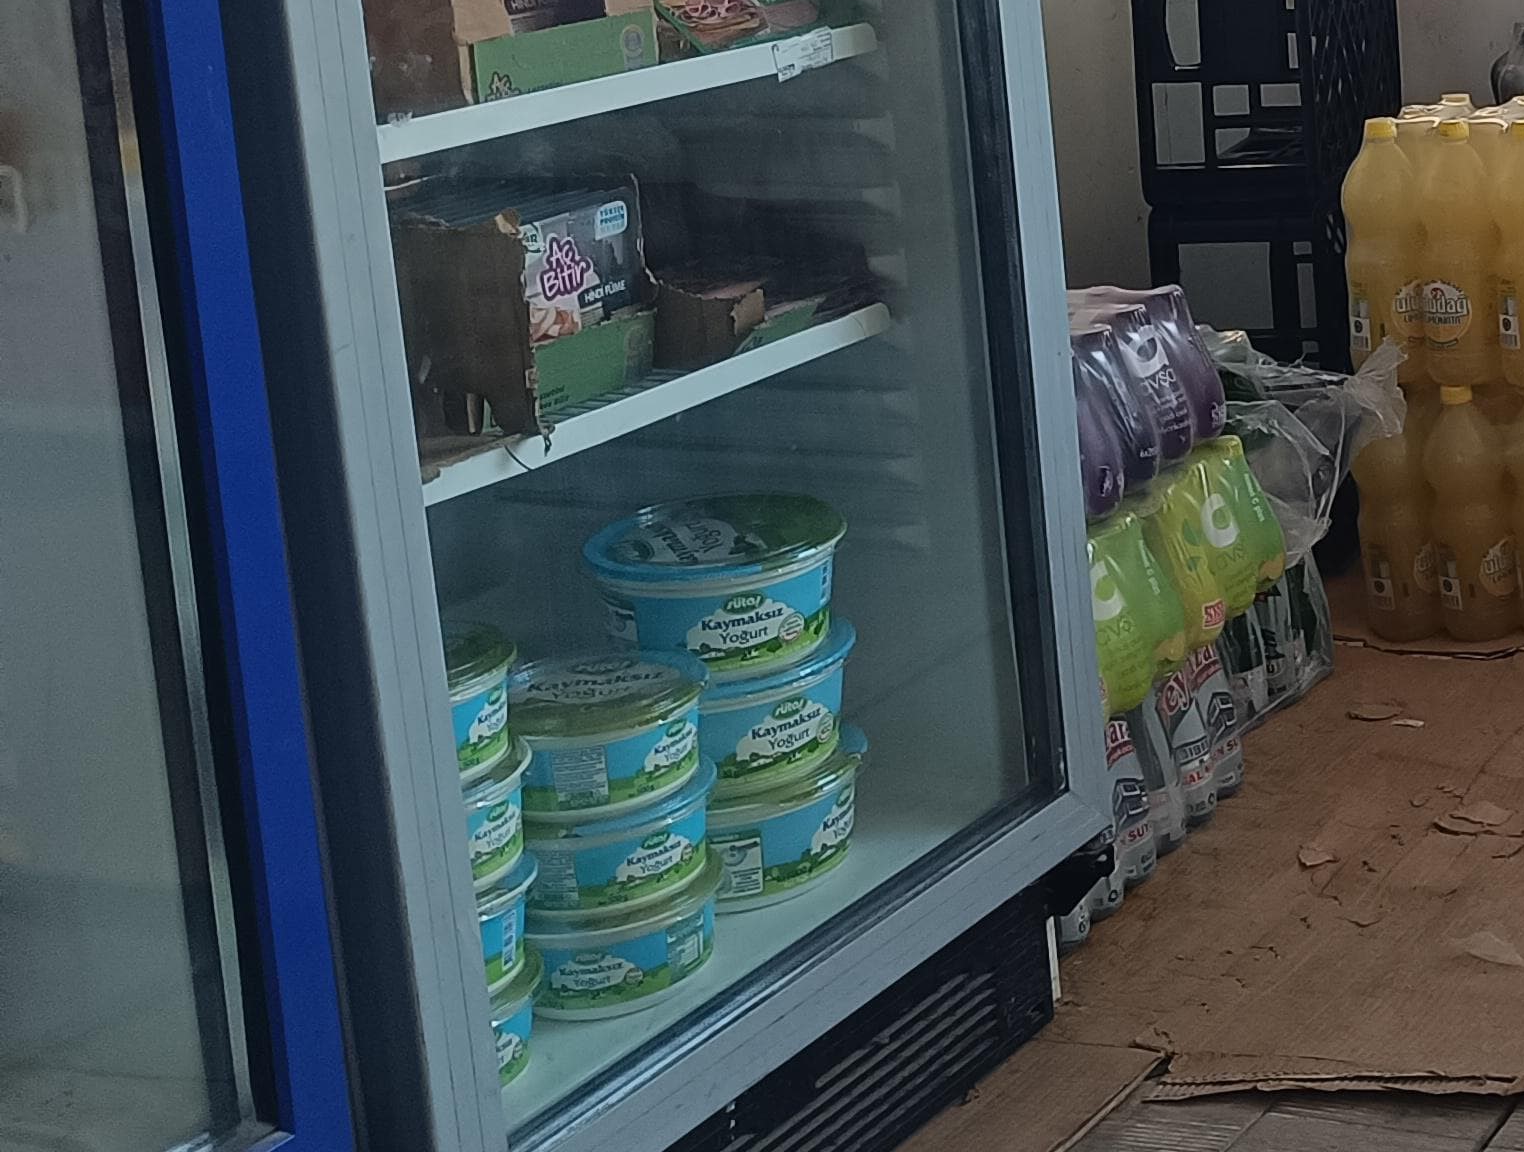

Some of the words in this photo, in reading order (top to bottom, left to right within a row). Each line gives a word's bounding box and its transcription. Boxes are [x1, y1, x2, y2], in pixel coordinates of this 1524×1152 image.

[542, 259, 588, 298] Bitir
[700, 606, 785, 633] Kaymaksız
[718, 625, 769, 645] Yoğurt
